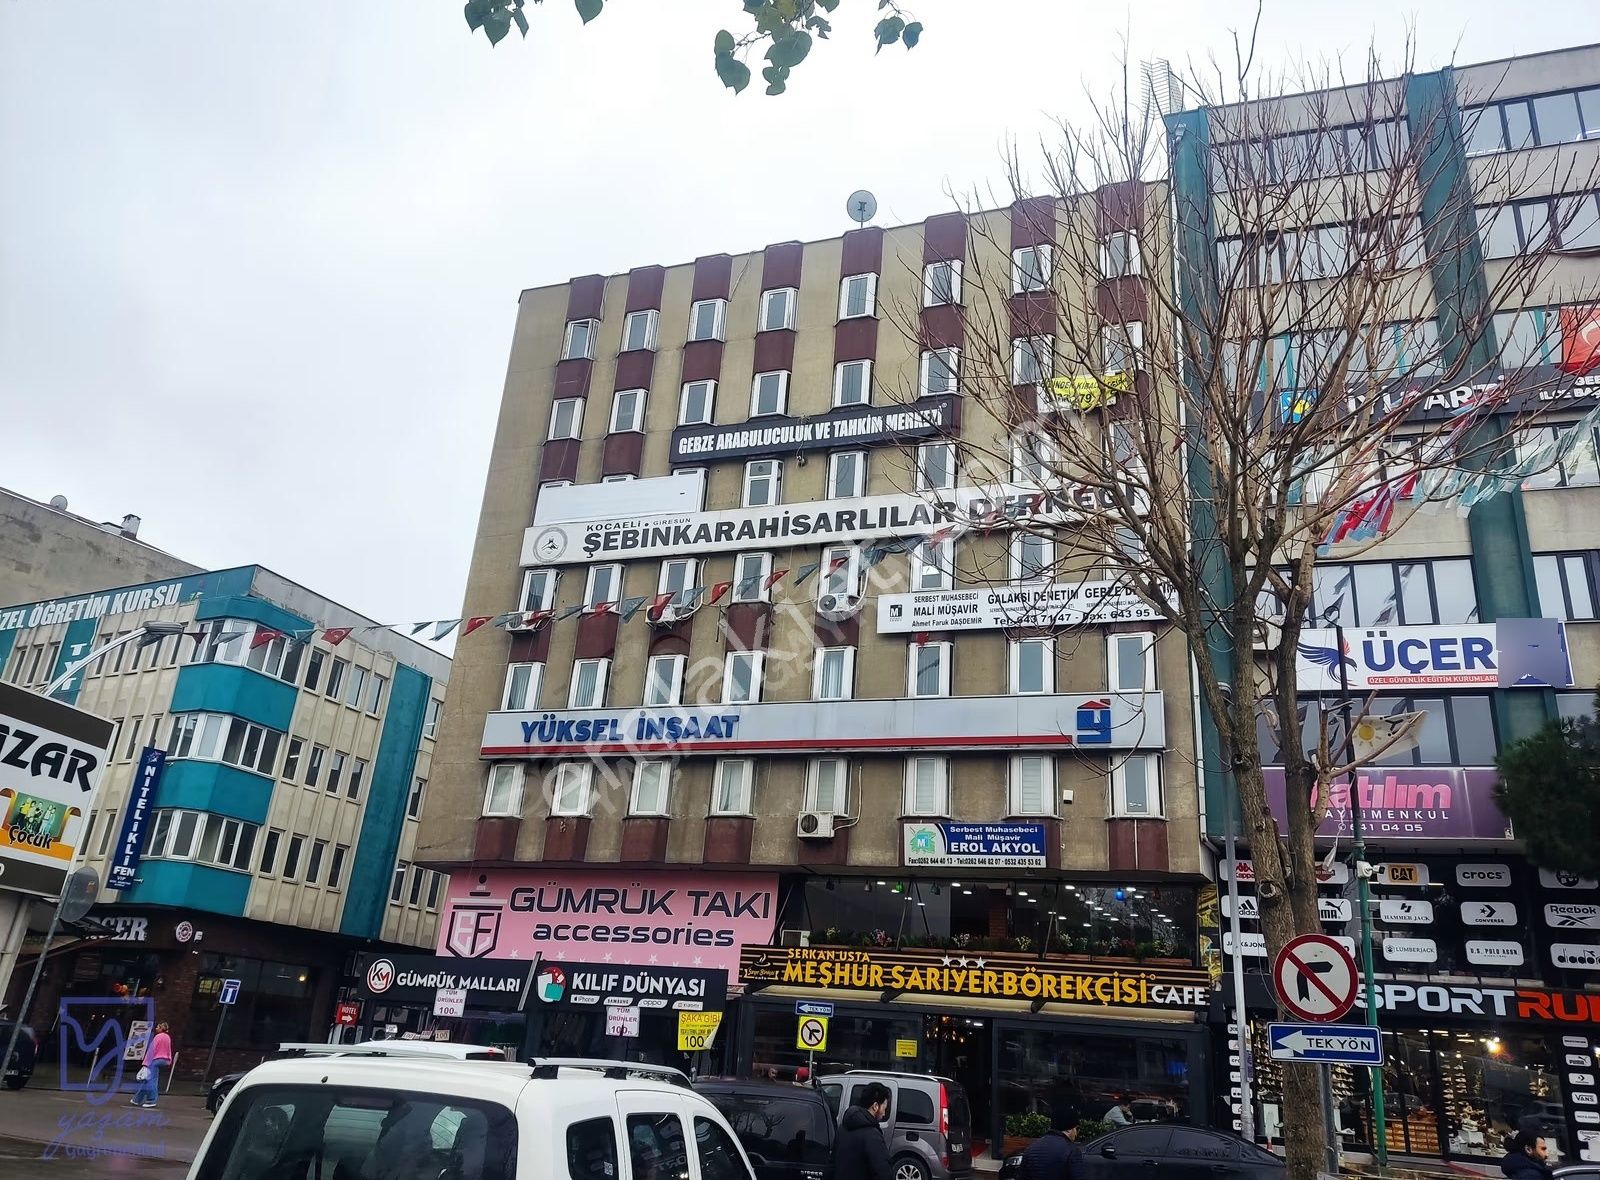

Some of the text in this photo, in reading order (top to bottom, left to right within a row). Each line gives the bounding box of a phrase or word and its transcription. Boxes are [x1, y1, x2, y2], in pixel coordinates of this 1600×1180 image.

[679, 408, 943, 455] GEBZE ARABULUCULUK VE TAHKİM MERKEZİ
[583, 501, 957, 559] ŞEBİNKARAHİSARLILAR
[915, 592, 979, 604] SERBEST MUHASEBECİ
[987, 587, 1031, 605] GALAKSİ
[1034, 585, 1079, 602] DENETİM
[0, 583, 182, 631] ZEL ÖĞRETİM KURSU
[914, 601, 978, 617] MALİ MÜŞAVİR
[912, 616, 983, 628] Ahmet Faruk DAŞDEMİR
[1058, 613, 1071, 623] 47
[1110, 609, 1132, 620] 643
[1136, 608, 1150, 618] 95
[1363, 630, 1497, 674] ÜÇER
[1369, 674, 1497, 684] ÖZEL GÜVENLİK EĞİTİM KURUMLARI
[521, 711, 739, 744] YÜKSEL İNŞAAT
[0, 724, 97, 793] ZAR
[123, 765, 156, 866] NİTELİKLİ
[9, 825, 53, 850] Çocuk
[951, 842, 1040, 853] EROL AKYOL
[113, 866, 135, 877] FEN
[1391, 867, 1414, 881] CAT
[1462, 871, 1503, 880] crocs
[509, 881, 771, 919] GÜMRÜK TAKI
[1549, 905, 1597, 914] Reebok
[532, 921, 735, 947] accessories
[788, 948, 870, 962] SERKAN USTA
[397, 969, 521, 993] GÜMRÜK MALLARI
[572, 971, 706, 997] KILIF DÜNYASI
[783, 960, 1206, 1007] MEŞHUR SARIYER BÖREKÇİSİ CAFE
[437, 996, 463, 1004] ÜRÜNLER
[643, 999, 662, 1007] oppo
[341, 1006, 357, 1015] HOTEL
[439, 1006, 454, 1015] 100
[608, 1015, 637, 1023] ÜRÜNLER
[681, 1014, 702, 1024] ŞAKA
[611, 1025, 628, 1035] 100
[685, 1035, 704, 1048] 100
[1306, 1037, 1370, 1051] TEK YÖN
